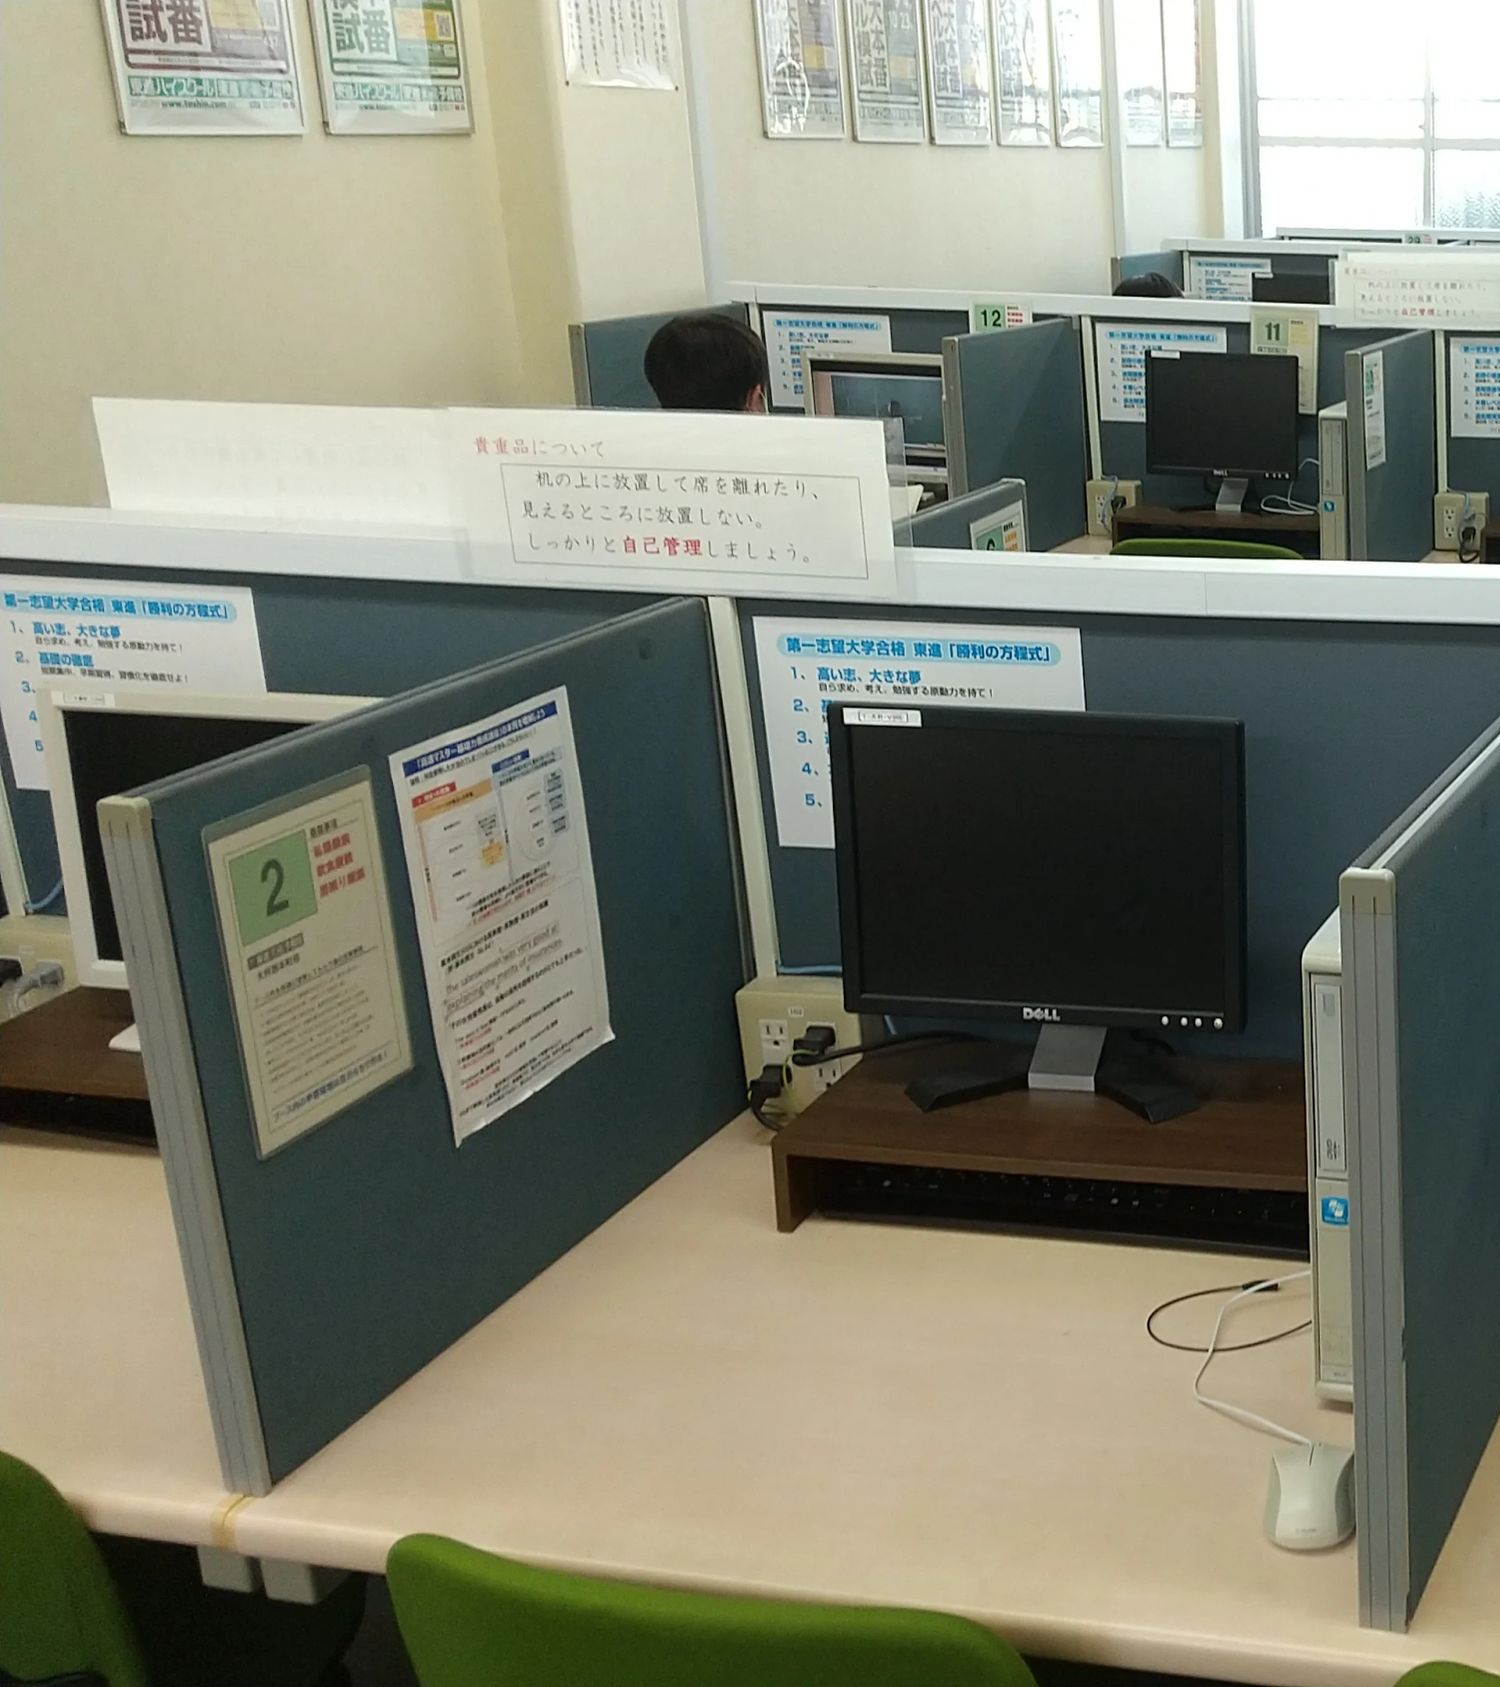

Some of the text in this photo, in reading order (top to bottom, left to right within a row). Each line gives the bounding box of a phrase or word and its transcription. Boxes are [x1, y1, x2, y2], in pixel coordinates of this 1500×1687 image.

[331, 0, 365, 53] 試
[981, 309, 1001, 327] 12
[1265, 322, 1280, 341] 11
[473, 435, 604, 459] 貴重品について
[535, 470, 819, 501] 机の上に放置して席を離れたり、
[521, 500, 763, 530] 見えるところに放置しない。
[529, 534, 811, 564] しっかりと自己管理しましょう。
[4, 593, 104, 613] 第一志望大学合格
[32, 622, 121, 639] 高い志、大きな夢
[786, 637, 1051, 662] 第一志望大学合格 東進「勝利の方程式」
[817, 667, 922, 684] 高い志、大きな夢
[261, 859, 289, 917] 2
[1022, 1007, 1061, 1021] DELL
